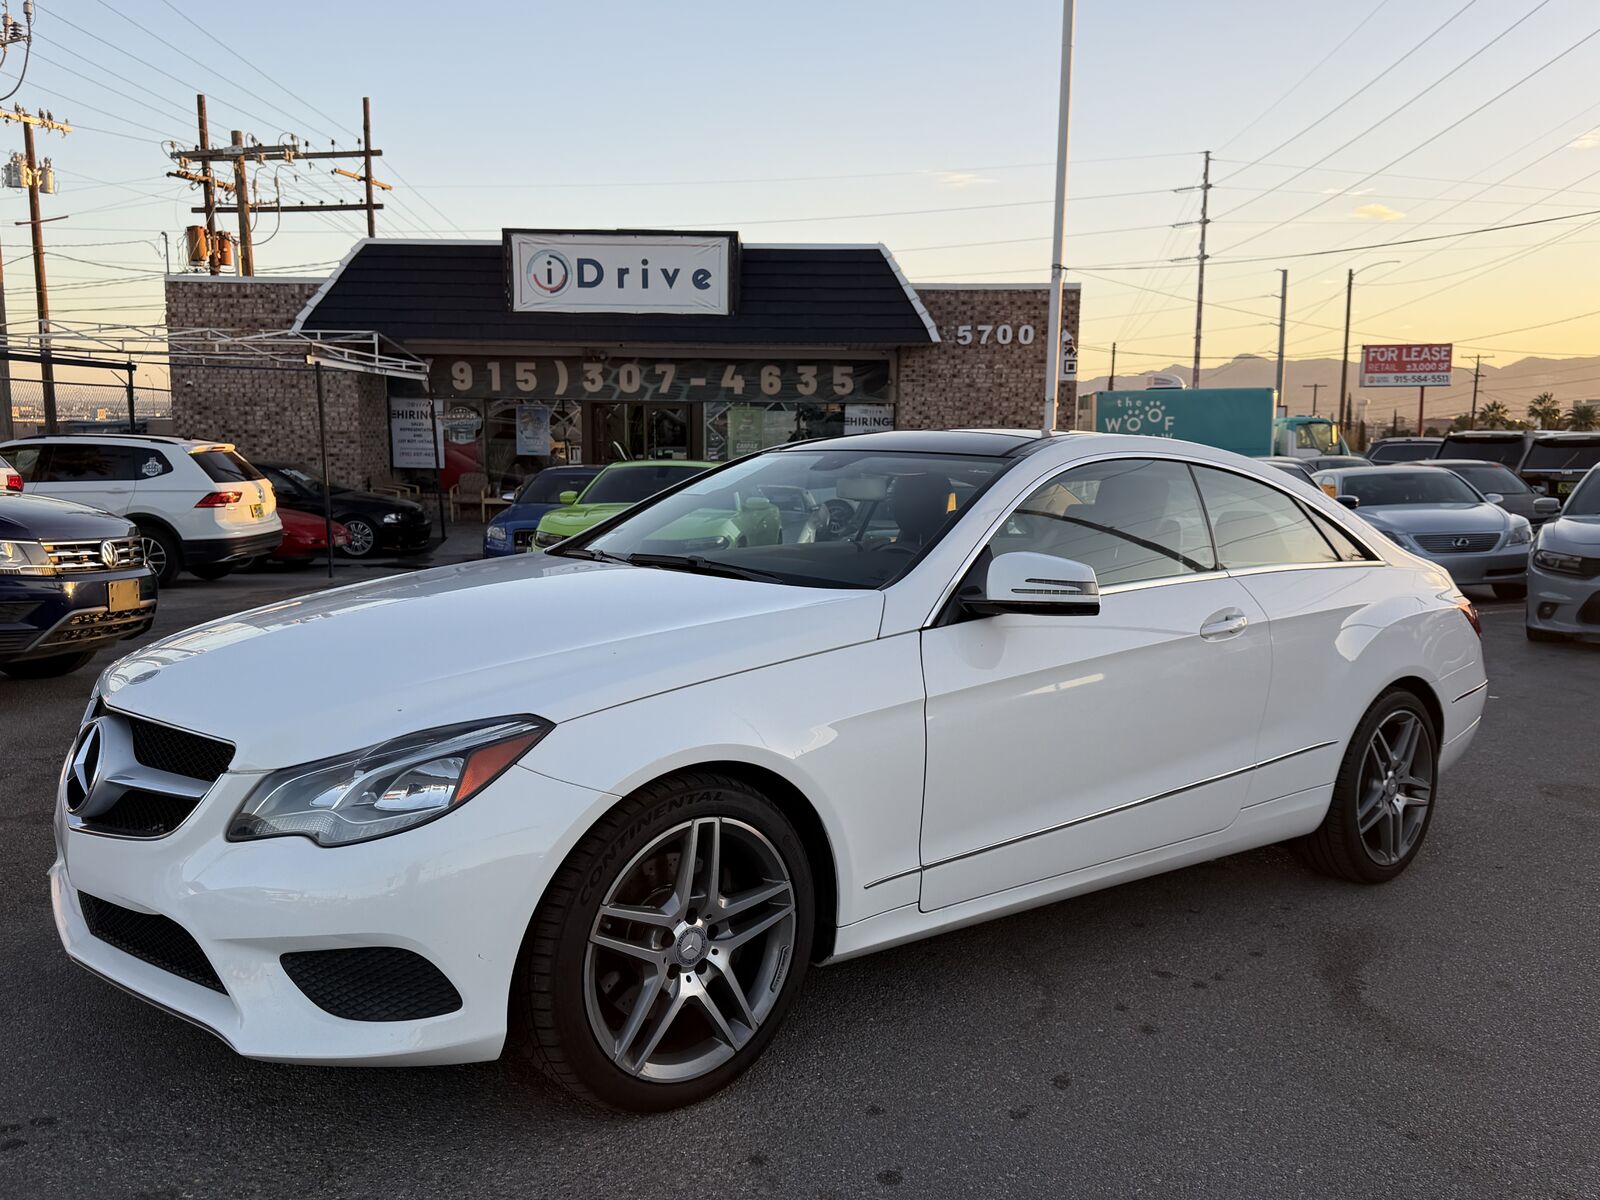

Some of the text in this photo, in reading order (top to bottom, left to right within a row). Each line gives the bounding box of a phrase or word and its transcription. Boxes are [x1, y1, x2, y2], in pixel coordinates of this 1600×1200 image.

[956, 324, 1035, 346] 5700
[1369, 346, 1451, 361] FOR LEASE
[1117, 397, 1142, 407] the
[850, 417, 890, 427] HIRING
[579, 790, 724, 906] CONTINENTAL
